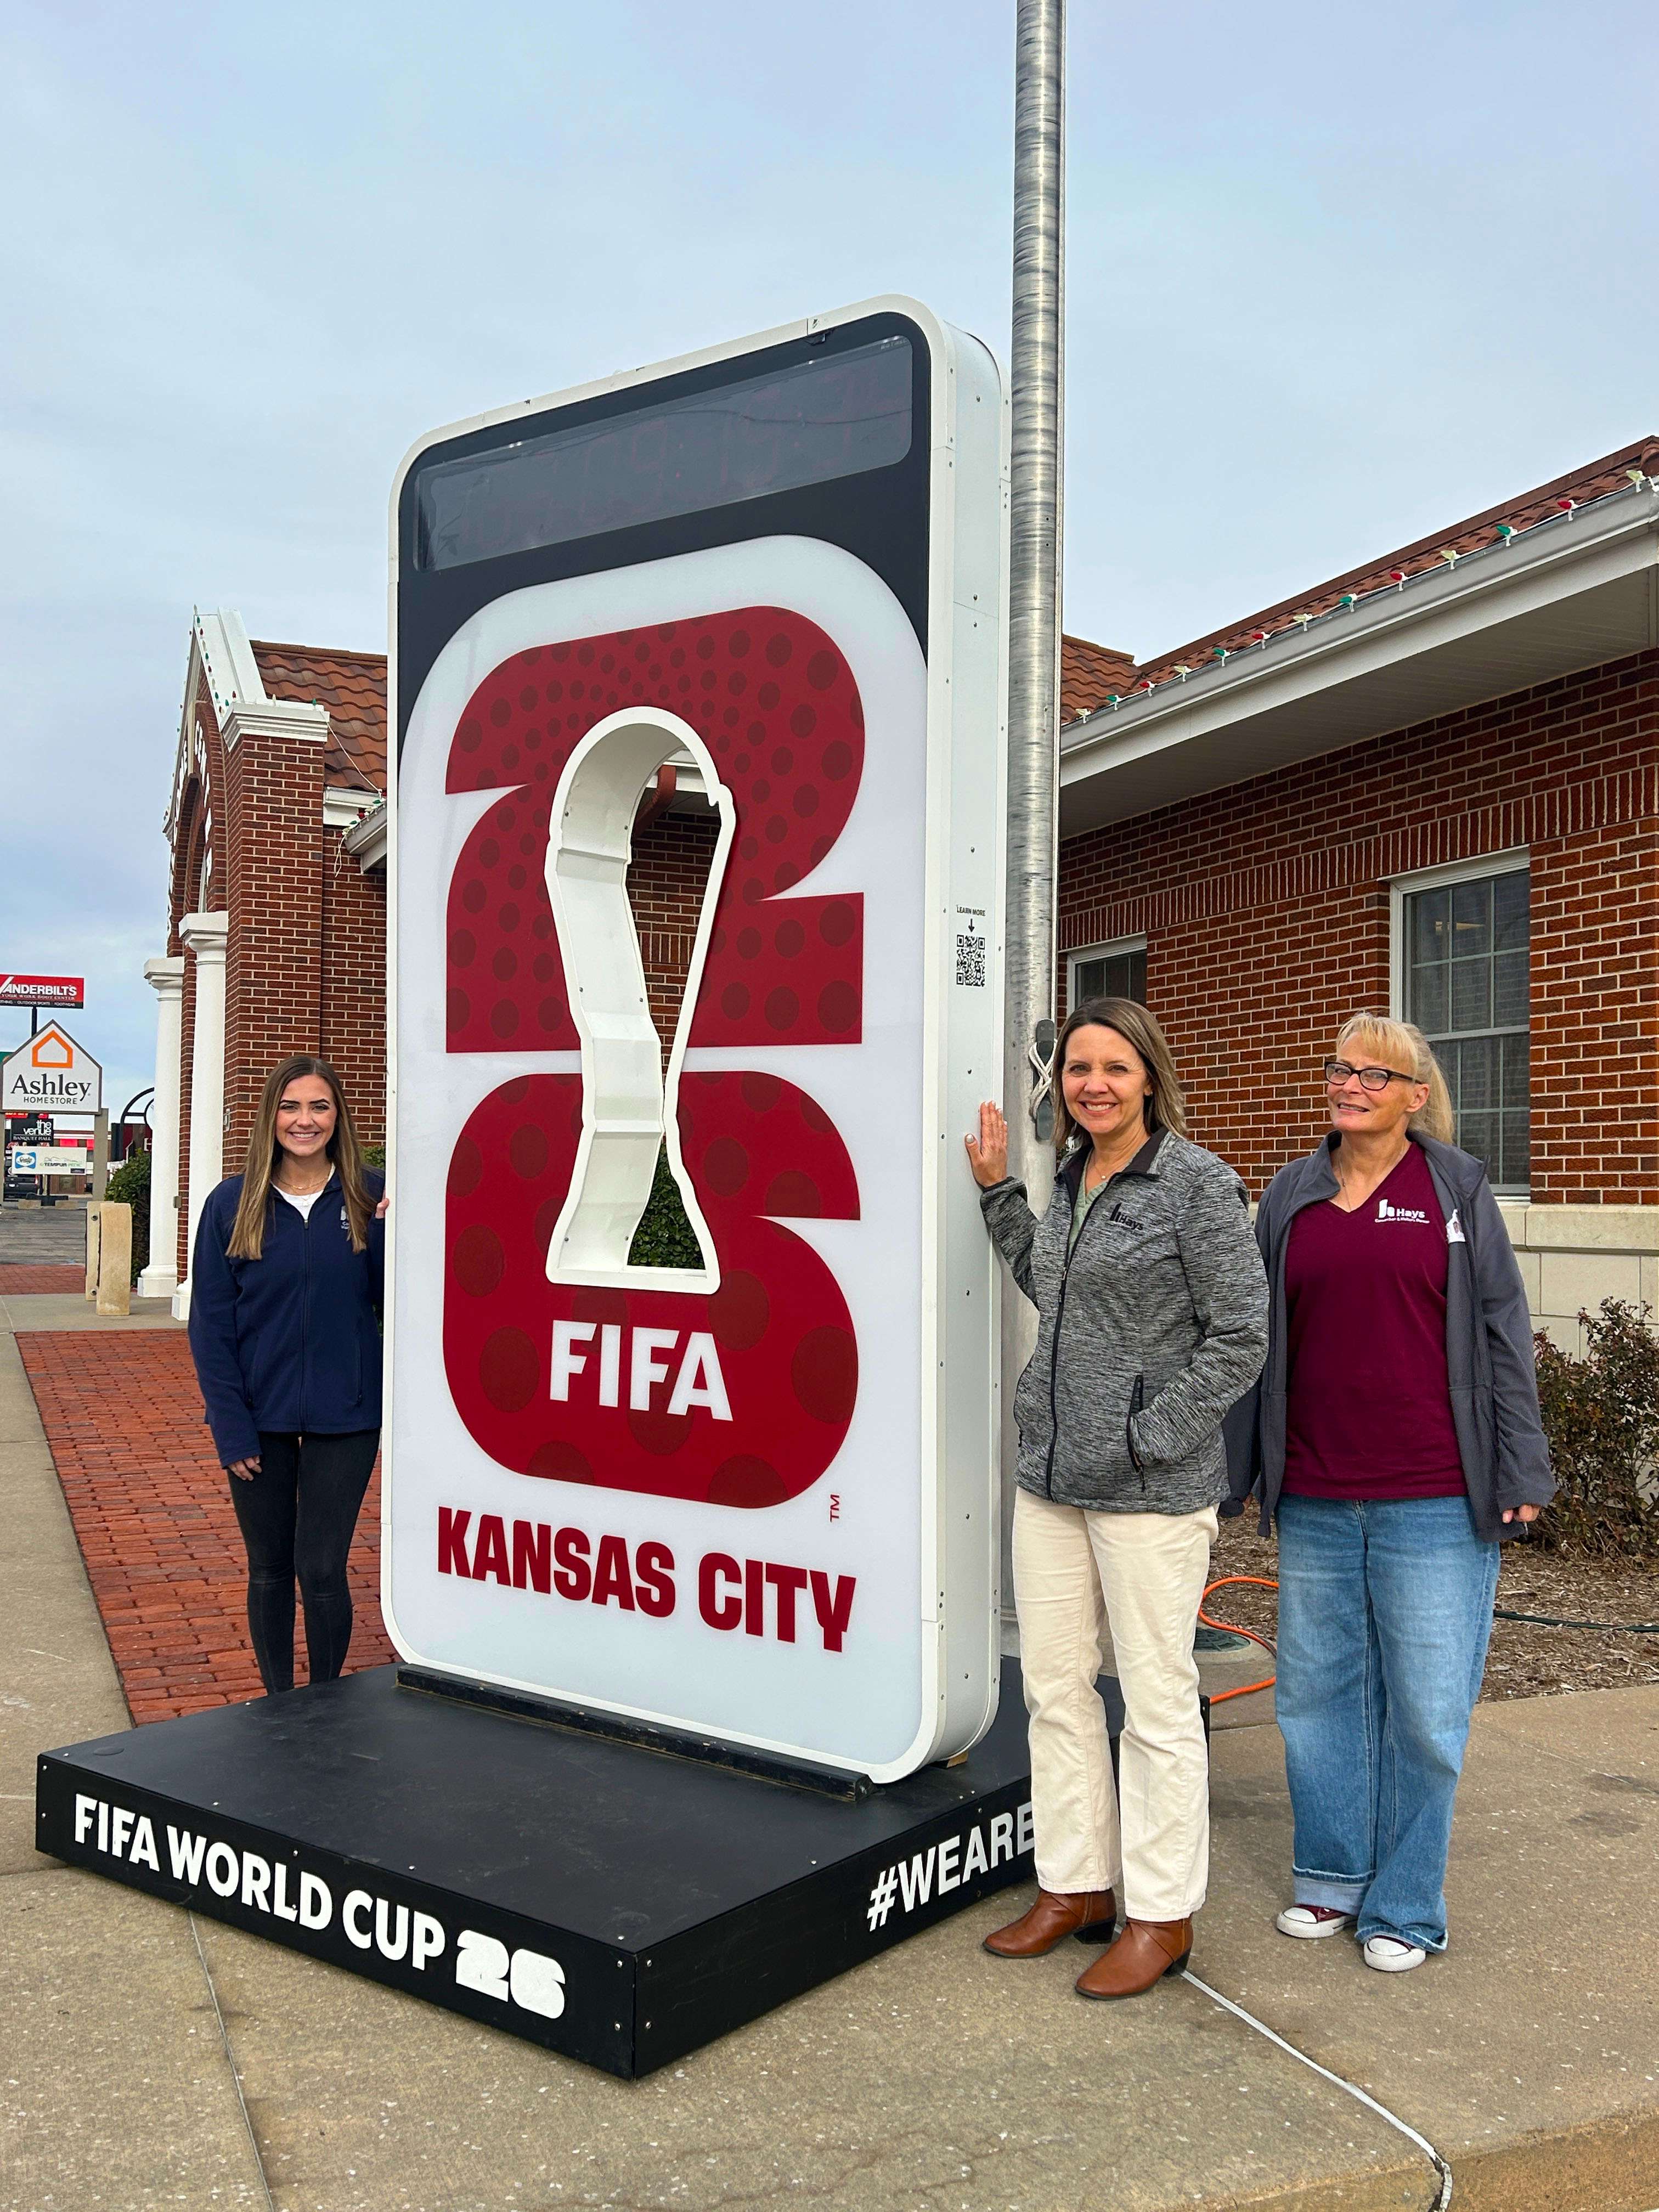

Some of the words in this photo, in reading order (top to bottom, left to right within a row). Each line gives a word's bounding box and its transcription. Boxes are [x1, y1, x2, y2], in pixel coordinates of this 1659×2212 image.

[957, 906, 972, 915] LEARN
[10, 1073, 92, 1102] Ashley
[24, 1096, 77, 1104] HOMESTORE
[36, 1120, 52, 1128] the
[1397, 1208, 1425, 1219] Hays
[550, 1320, 733, 1421] FIFA
[438, 1506, 676, 1618] KANSAS
[698, 1552, 856, 1652] CITY
[75, 1793, 160, 1872] FIFA
[166, 1825, 332, 1930] WORLD
[342, 1889, 446, 1971] CUP
[456, 1929, 566, 2019] 26
